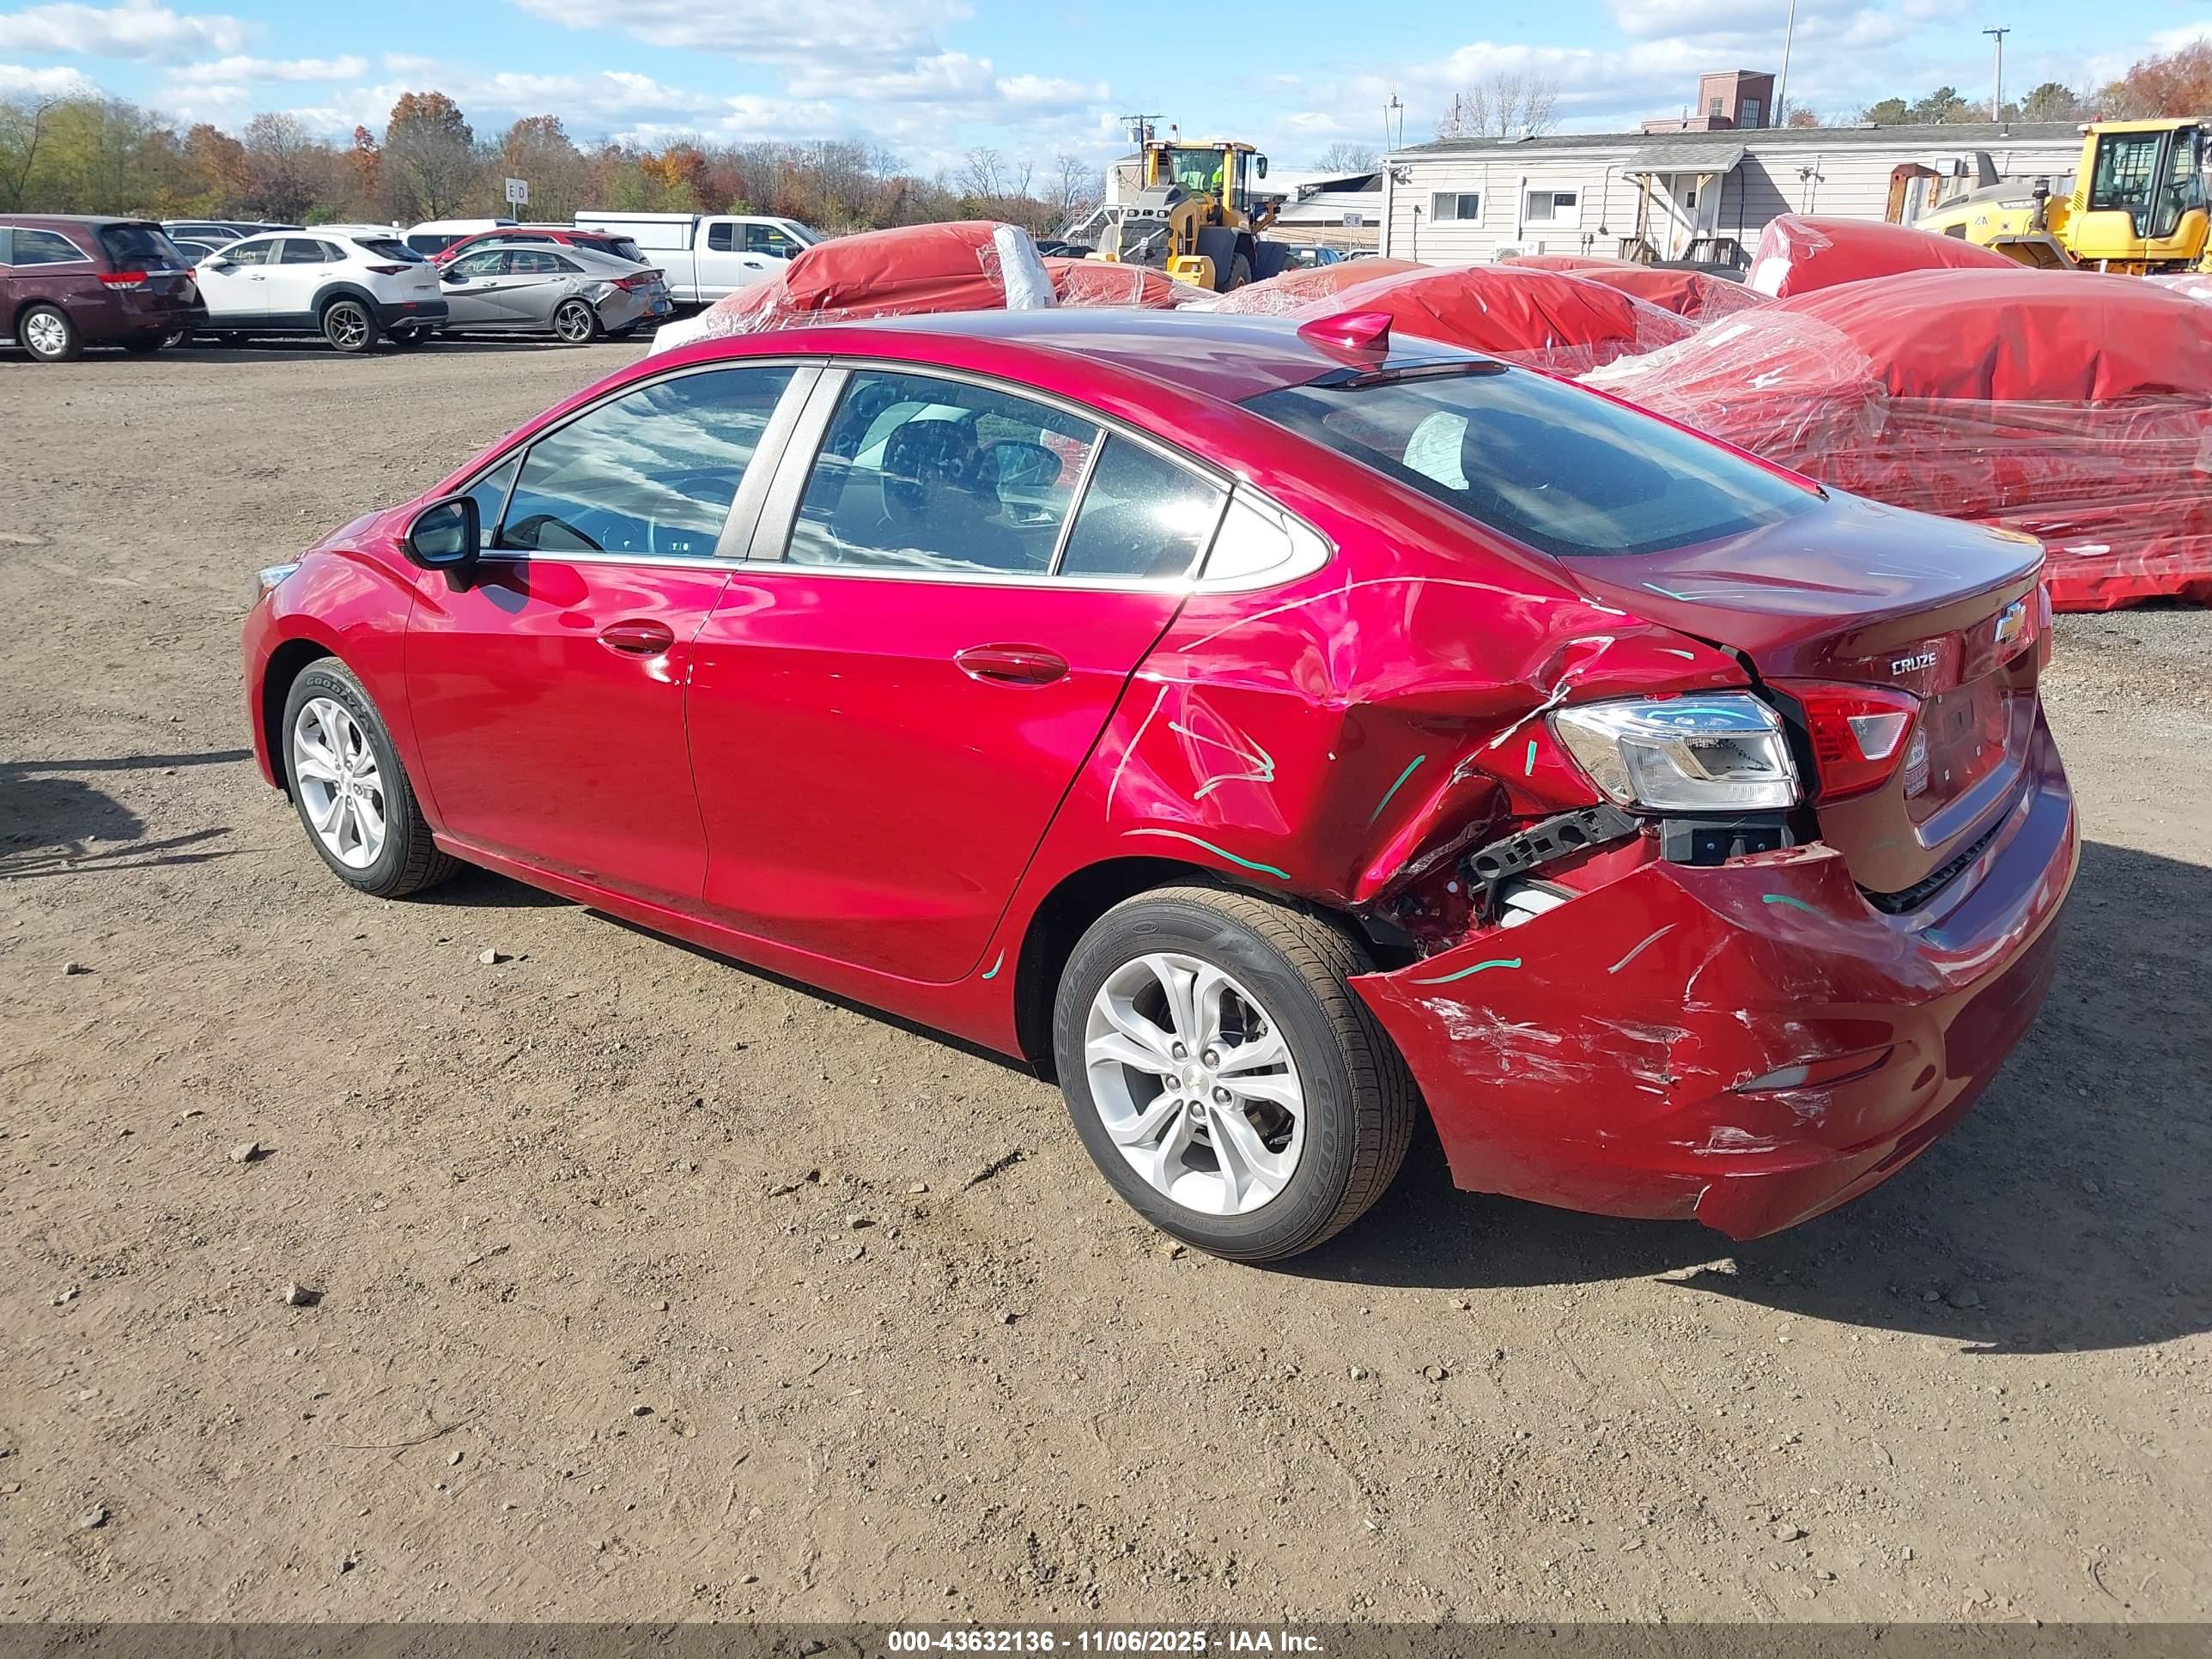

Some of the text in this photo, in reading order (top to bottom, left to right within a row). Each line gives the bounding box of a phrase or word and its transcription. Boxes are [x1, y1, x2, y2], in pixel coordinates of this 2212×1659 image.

[509, 185, 525, 198] E D
[2002, 199, 2036, 208] VOLV
[1355, 216, 1360, 225] B
[1893, 653, 1936, 675] CRUZE
[306, 676, 380, 748] GOODYEAR
